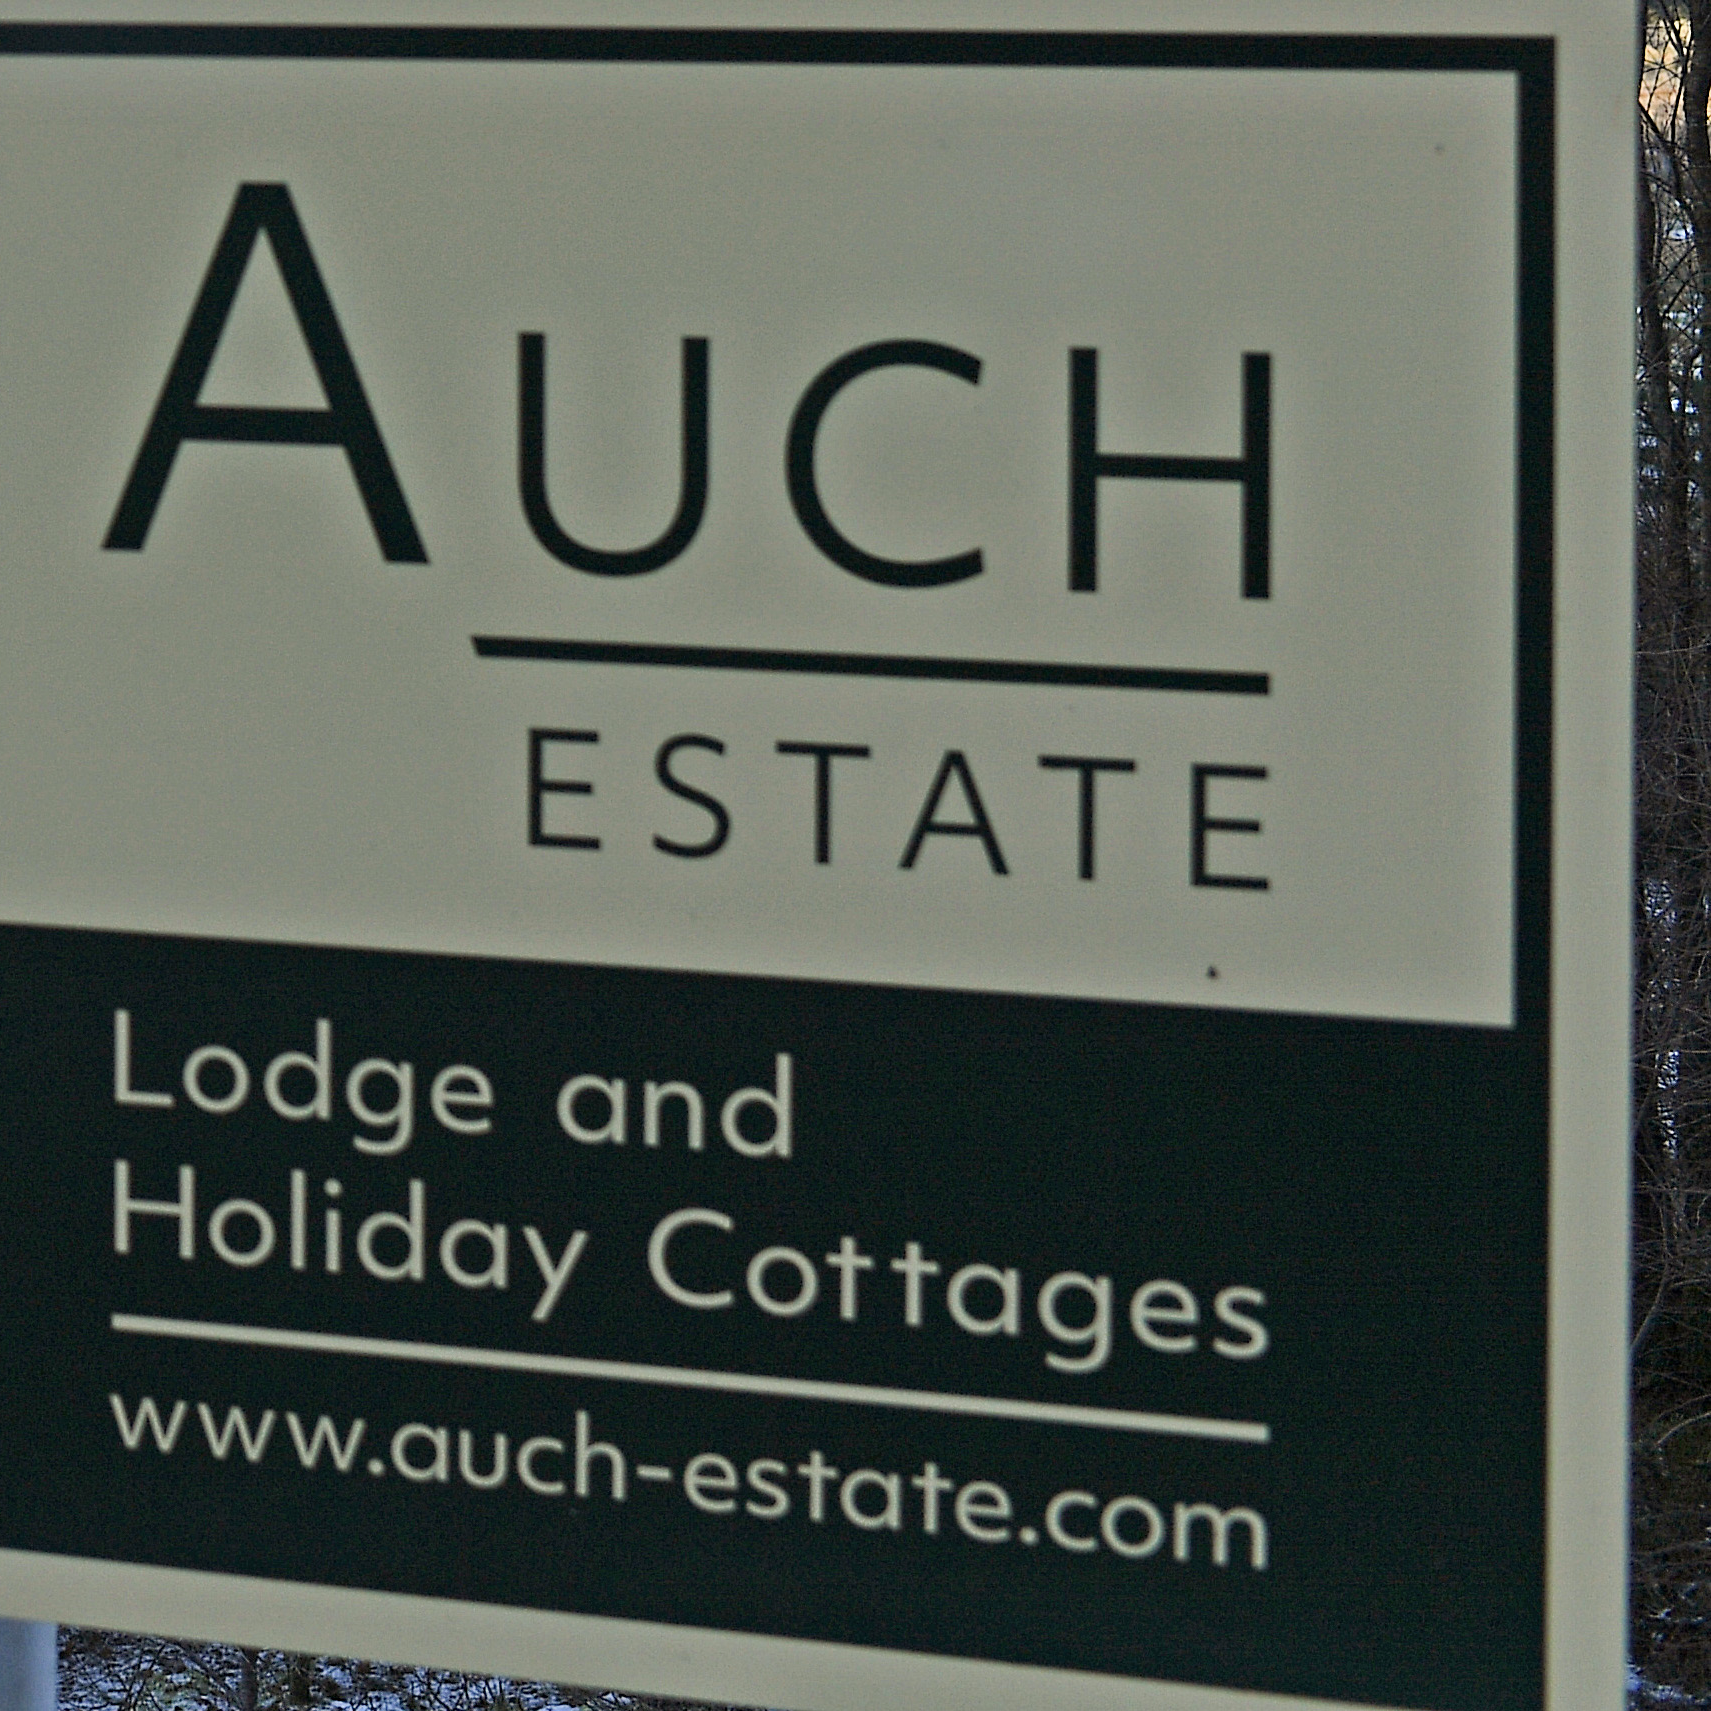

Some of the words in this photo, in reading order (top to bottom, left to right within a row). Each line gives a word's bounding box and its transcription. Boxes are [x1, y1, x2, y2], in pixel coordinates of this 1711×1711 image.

[103, 182, 1271, 600] AUCH
[527, 728, 1271, 892] ESTATE
[114, 1009, 493, 1155] Lodge
[556, 1052, 792, 1158] and
[114, 1159, 588, 1322] Holiday
[649, 1208, 1268, 1373] Cottages
[110, 1393, 1268, 1570] www.auch-estate.com
